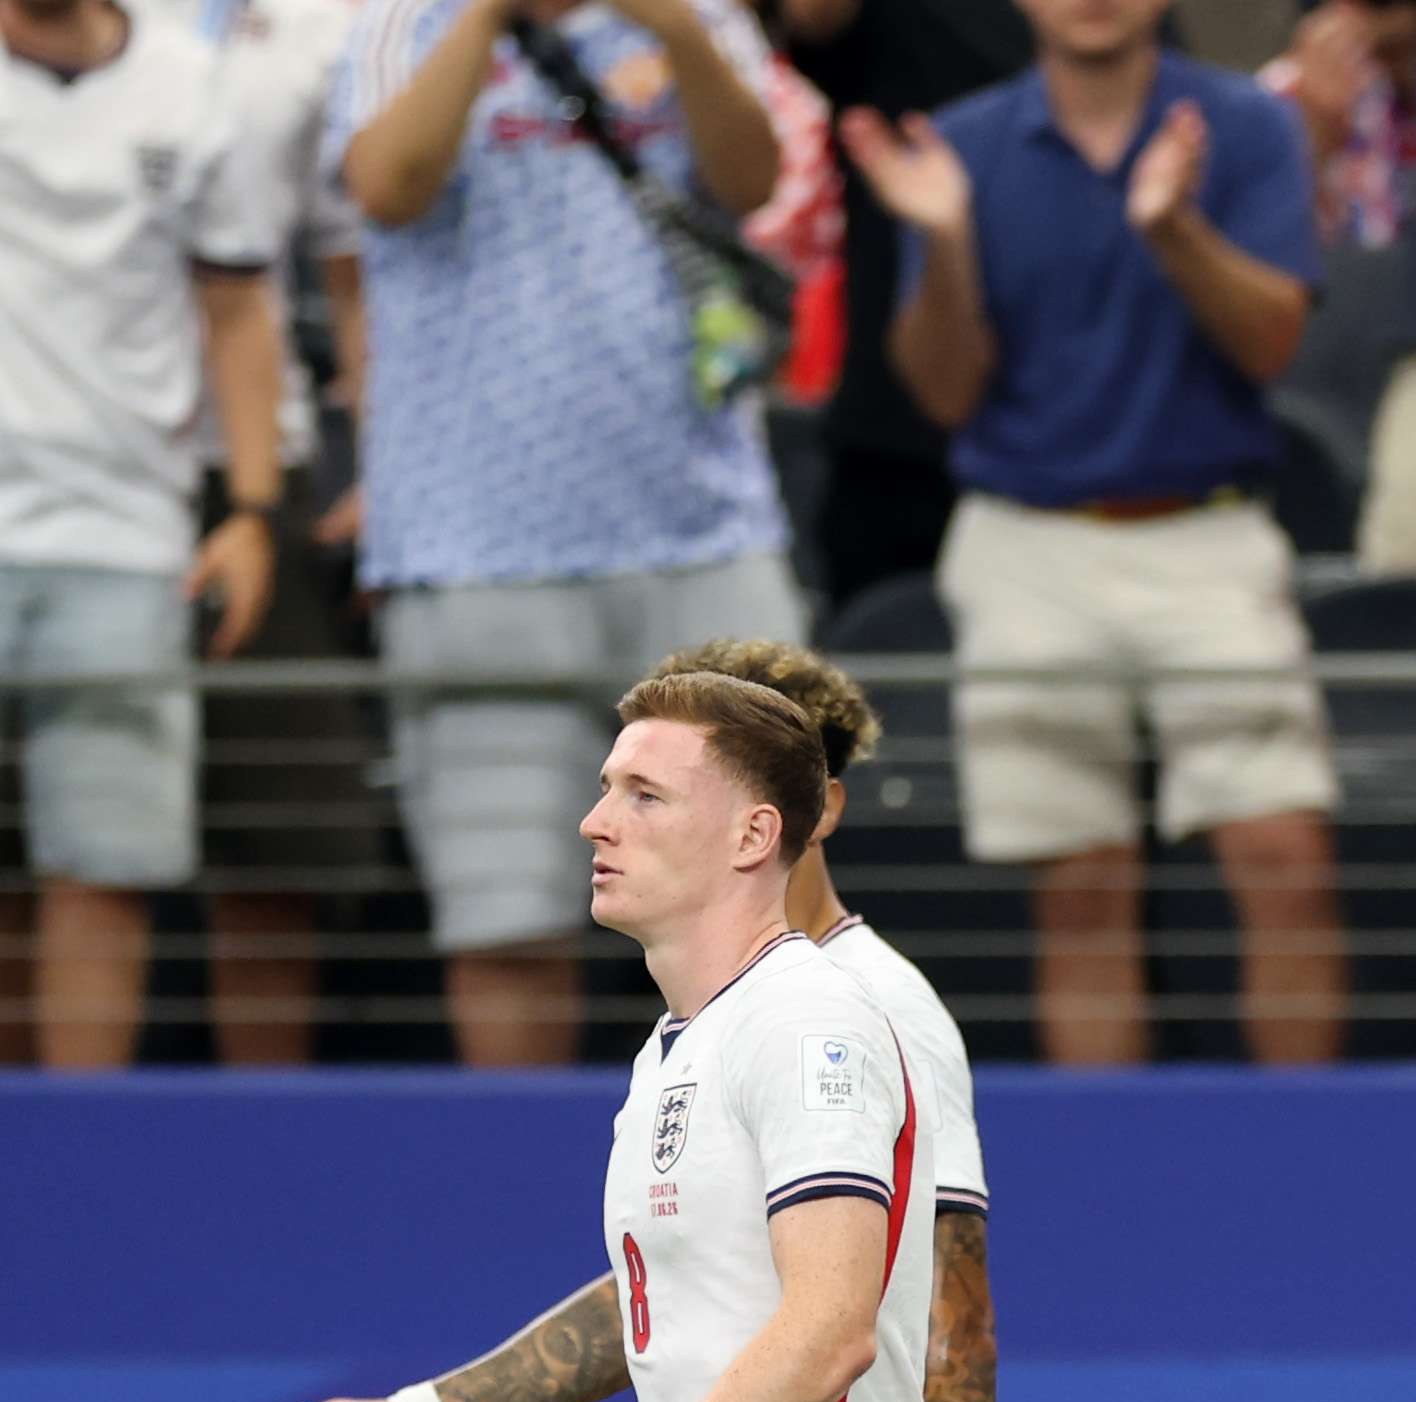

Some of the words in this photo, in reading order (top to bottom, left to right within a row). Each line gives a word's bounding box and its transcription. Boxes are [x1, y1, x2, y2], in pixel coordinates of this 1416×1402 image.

[820, 1082, 853, 1097] PEACE
[649, 1182, 679, 1198] CROATIA
[622, 1232, 651, 1354] 8
